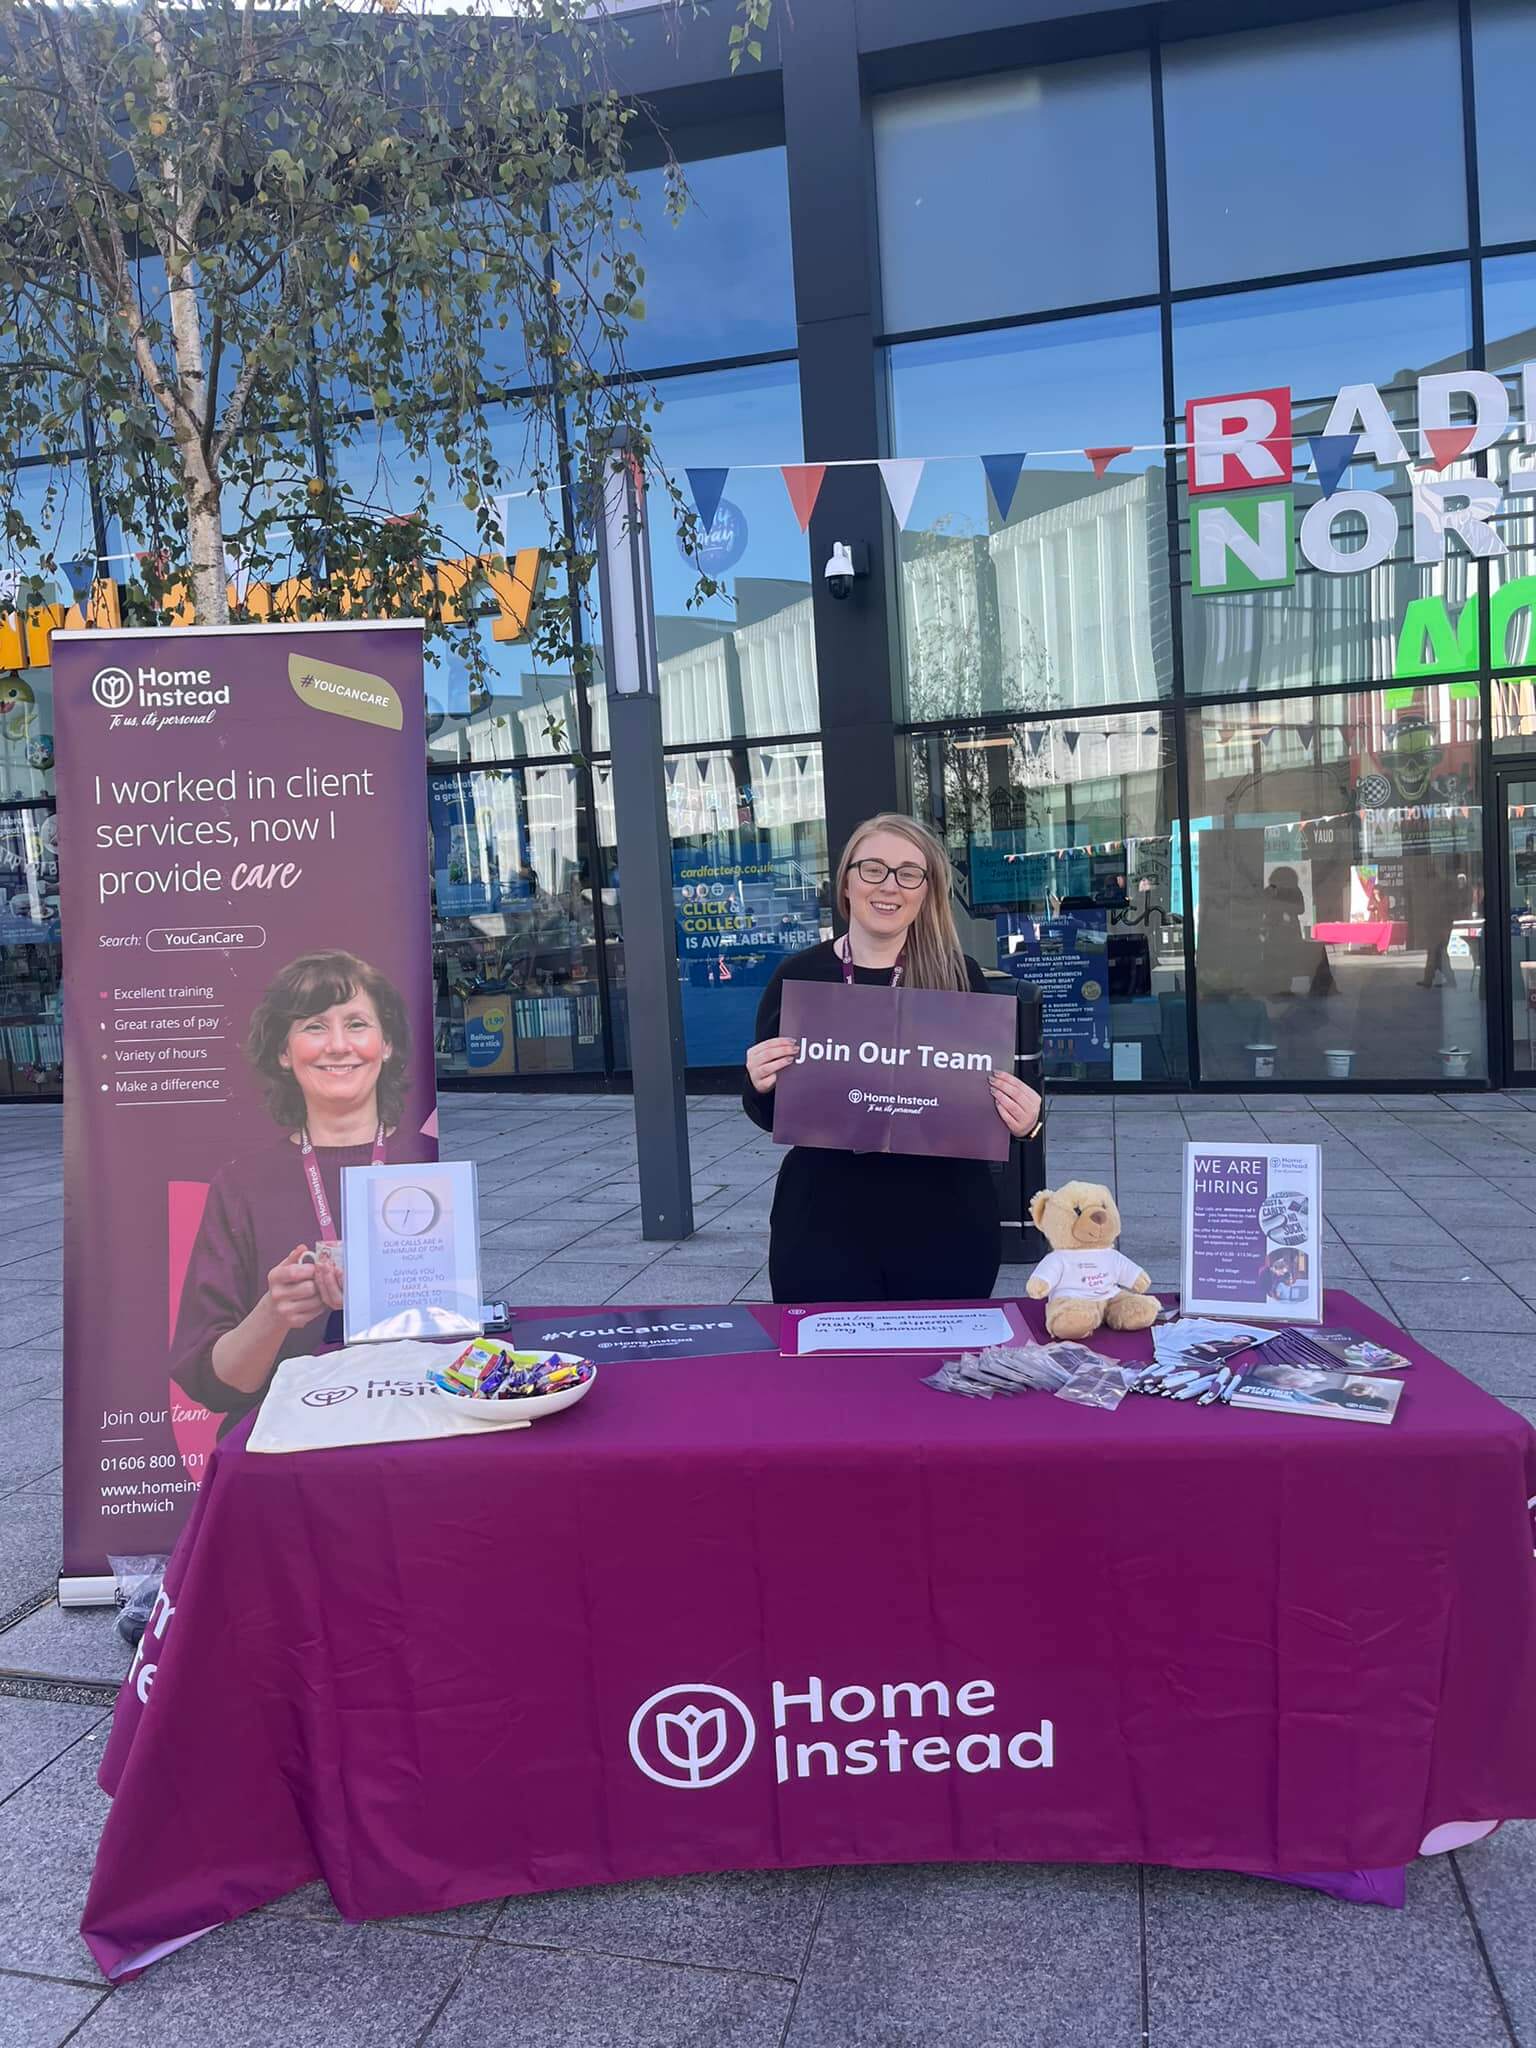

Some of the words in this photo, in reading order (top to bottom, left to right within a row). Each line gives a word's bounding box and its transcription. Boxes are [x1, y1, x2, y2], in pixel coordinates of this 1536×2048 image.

[138, 667, 211, 686] Home
[139, 686, 231, 707] Instead
[300, 674, 391, 707] #YOUCANCARE
[109, 714, 124, 730] To
[156, 708, 217, 731] personal
[94, 775, 101, 804] I
[111, 769, 236, 804] worked
[248, 770, 275, 800] in
[286, 767, 375, 798] client
[96, 815, 240, 849] services,
[250, 817, 320, 842] now
[330, 810, 336, 840] I
[99, 860, 222, 904] provide
[231, 862, 302, 891] care
[683, 901, 728, 915] CLICK
[730, 901, 740, 912] &
[684, 916, 752, 932] COLLECT
[99, 934, 142, 948] Search:
[165, 931, 244, 945] YouCanCare
[686, 937, 698, 949] IS
[701, 932, 775, 948] AVAILABLE
[778, 930, 815, 943] HERE
[114, 987, 165, 1000] Excellent
[168, 986, 214, 1000] training
[114, 1019, 147, 1031] Great
[151, 1018, 180, 1030] rates
[183, 1016, 195, 1028] of
[198, 1017, 219, 1030] pay
[115, 1050, 156, 1063] Variety
[158, 1048, 171, 1059] of
[173, 1047, 208, 1059] hours
[796, 1038, 850, 1064] Join
[859, 1041, 910, 1066] Our
[917, 1045, 993, 1072] Team
[115, 1081, 147, 1092] Make
[151, 1083, 158, 1091] a
[160, 1078, 220, 1091] difference
[864, 1092, 896, 1104] Home
[1195, 1160, 1221, 1173] WE
[1227, 1160, 1261, 1174] ARE
[1195, 1180, 1258, 1194] HIRING
[542, 1321, 734, 1341] #YouCanCare
[100, 1410, 134, 1430] Join
[139, 1410, 168, 1424] our
[172, 1404, 211, 1423] team
[101, 1456, 146, 1471] 01606
[149, 1454, 176, 1469] 800
[180, 1453, 204, 1467] 101
[101, 1498, 174, 1515] northwich
[772, 1675, 996, 1729] Home
[776, 1718, 1055, 1785] Instead
